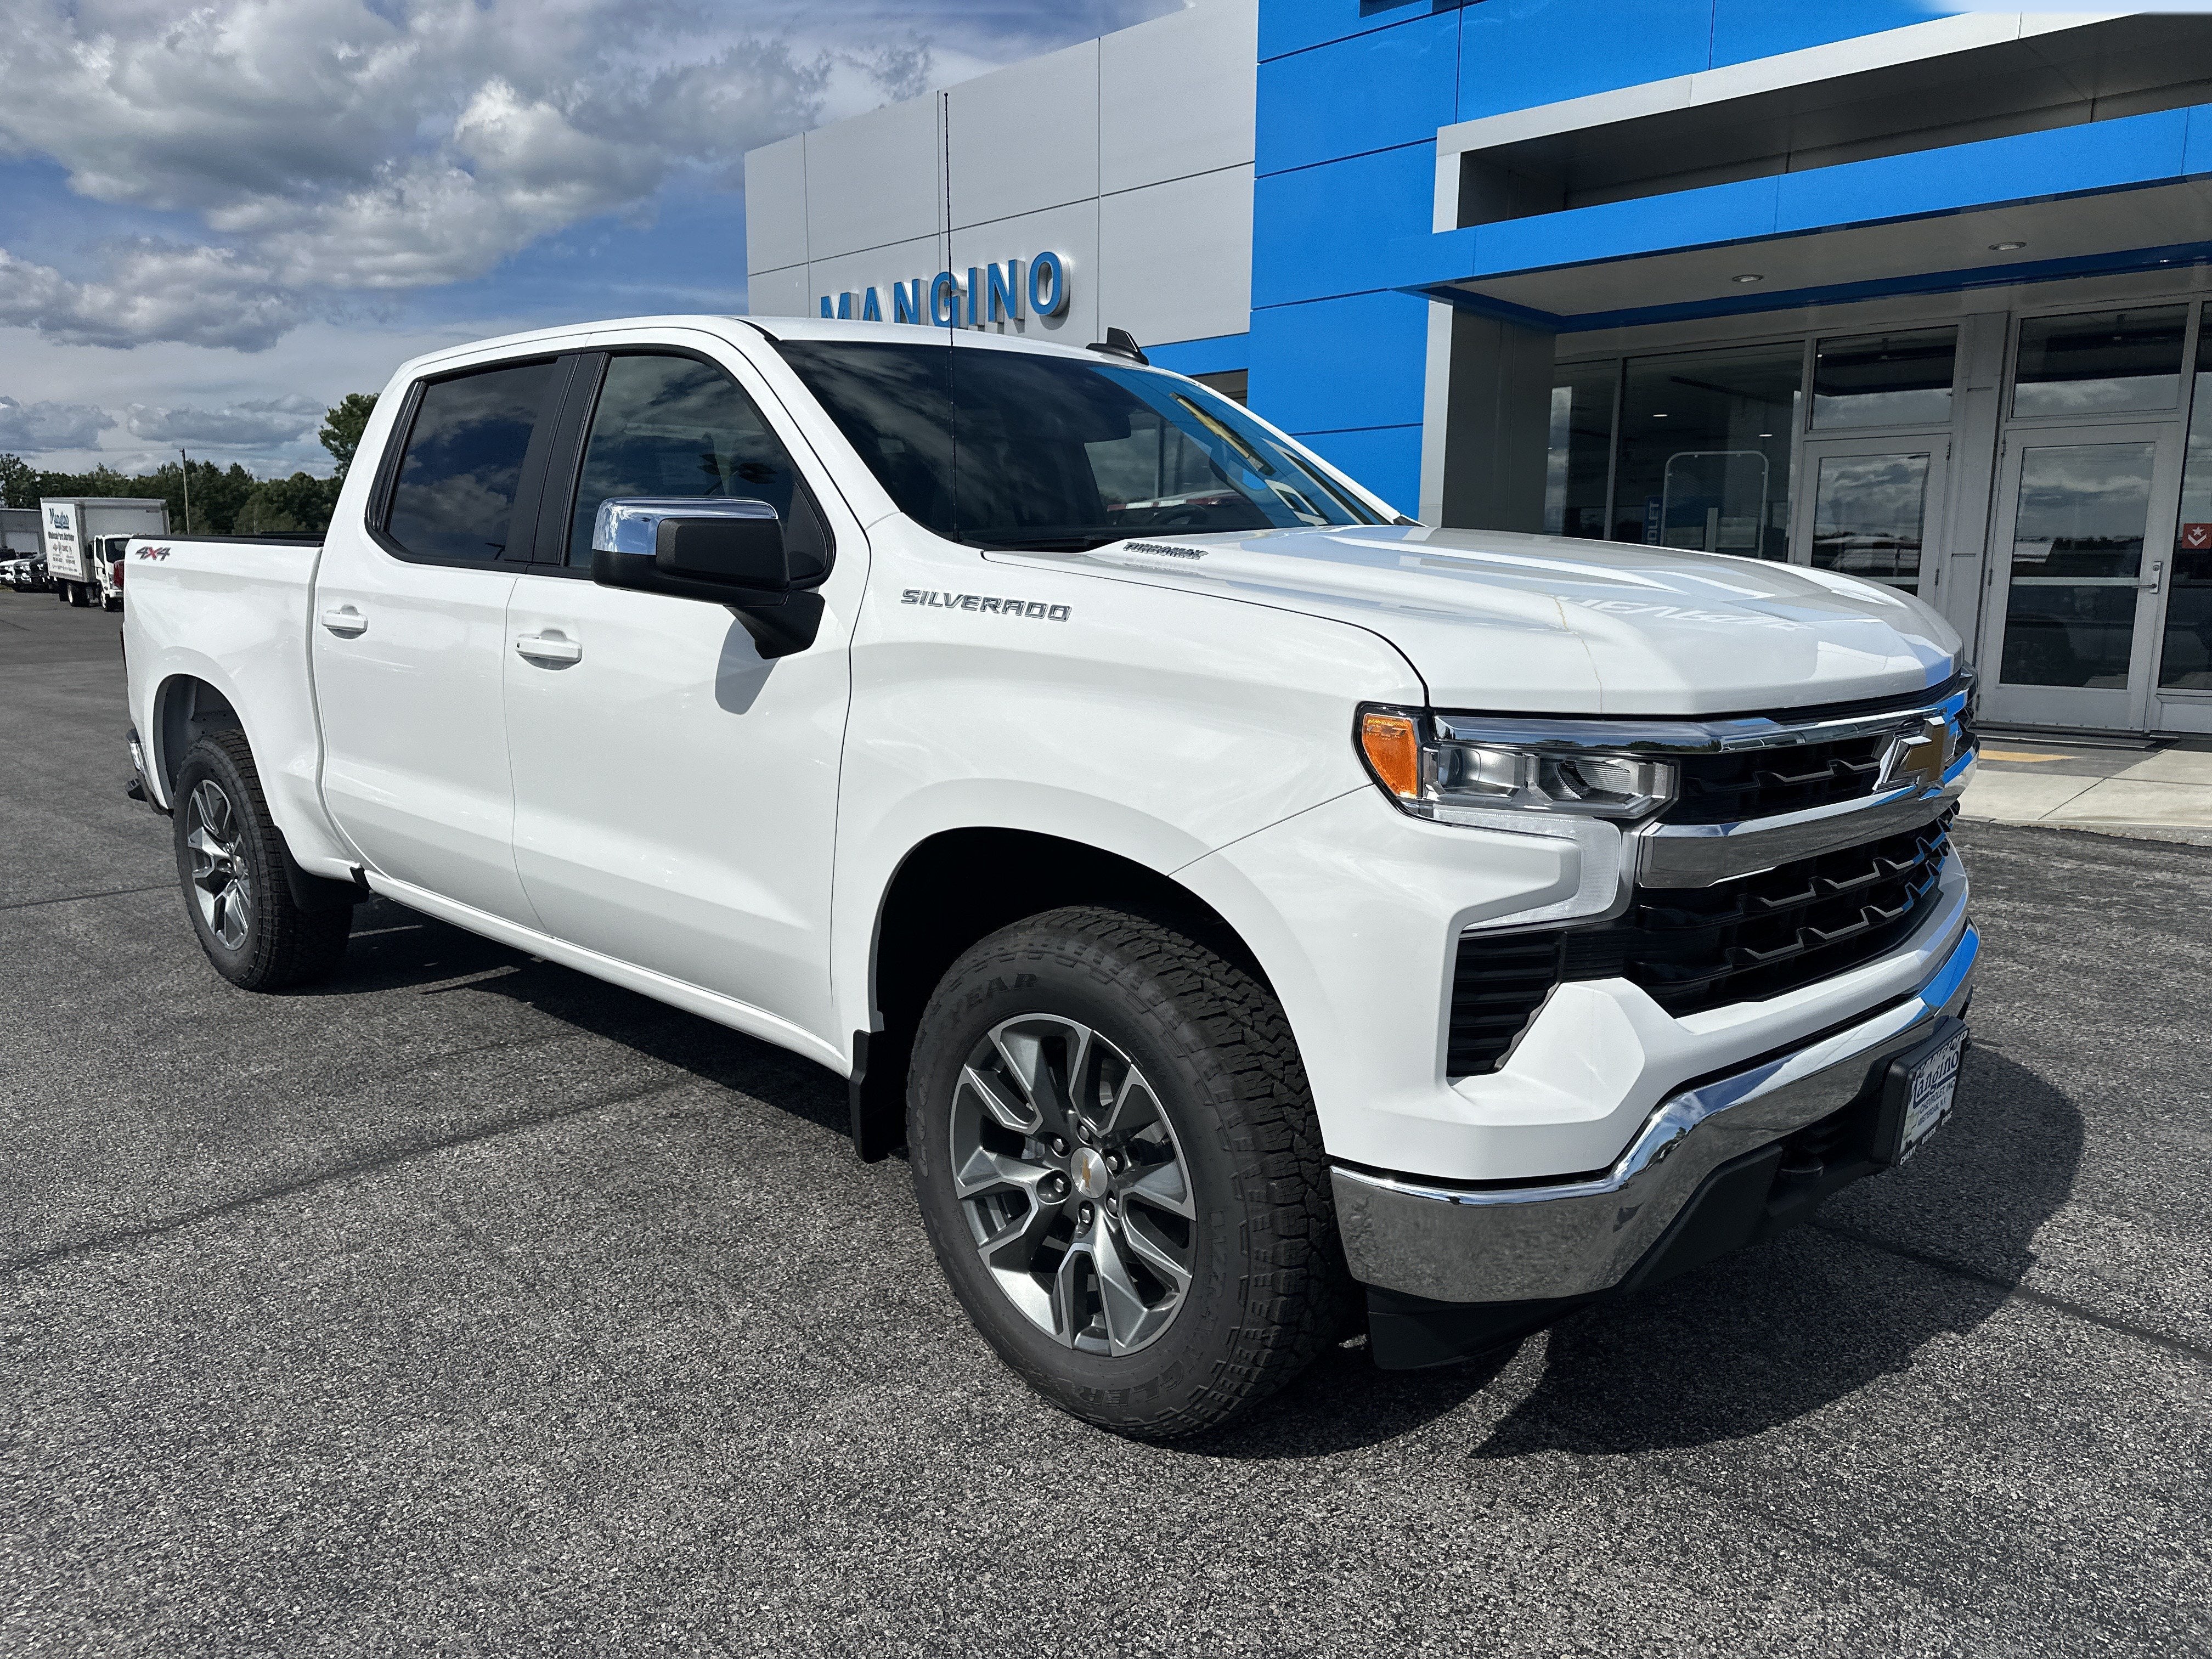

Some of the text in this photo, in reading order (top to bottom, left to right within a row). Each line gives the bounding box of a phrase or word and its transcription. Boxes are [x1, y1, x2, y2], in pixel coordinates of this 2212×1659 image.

[821, 251, 1070, 329] MANGINO
[1647, 501, 1659, 544] OLET
[901, 589, 1072, 622] SILVERADO
[1900, 1144, 1917, 1165] CHEVY
[1921, 1125, 1937, 1146] BUICK
